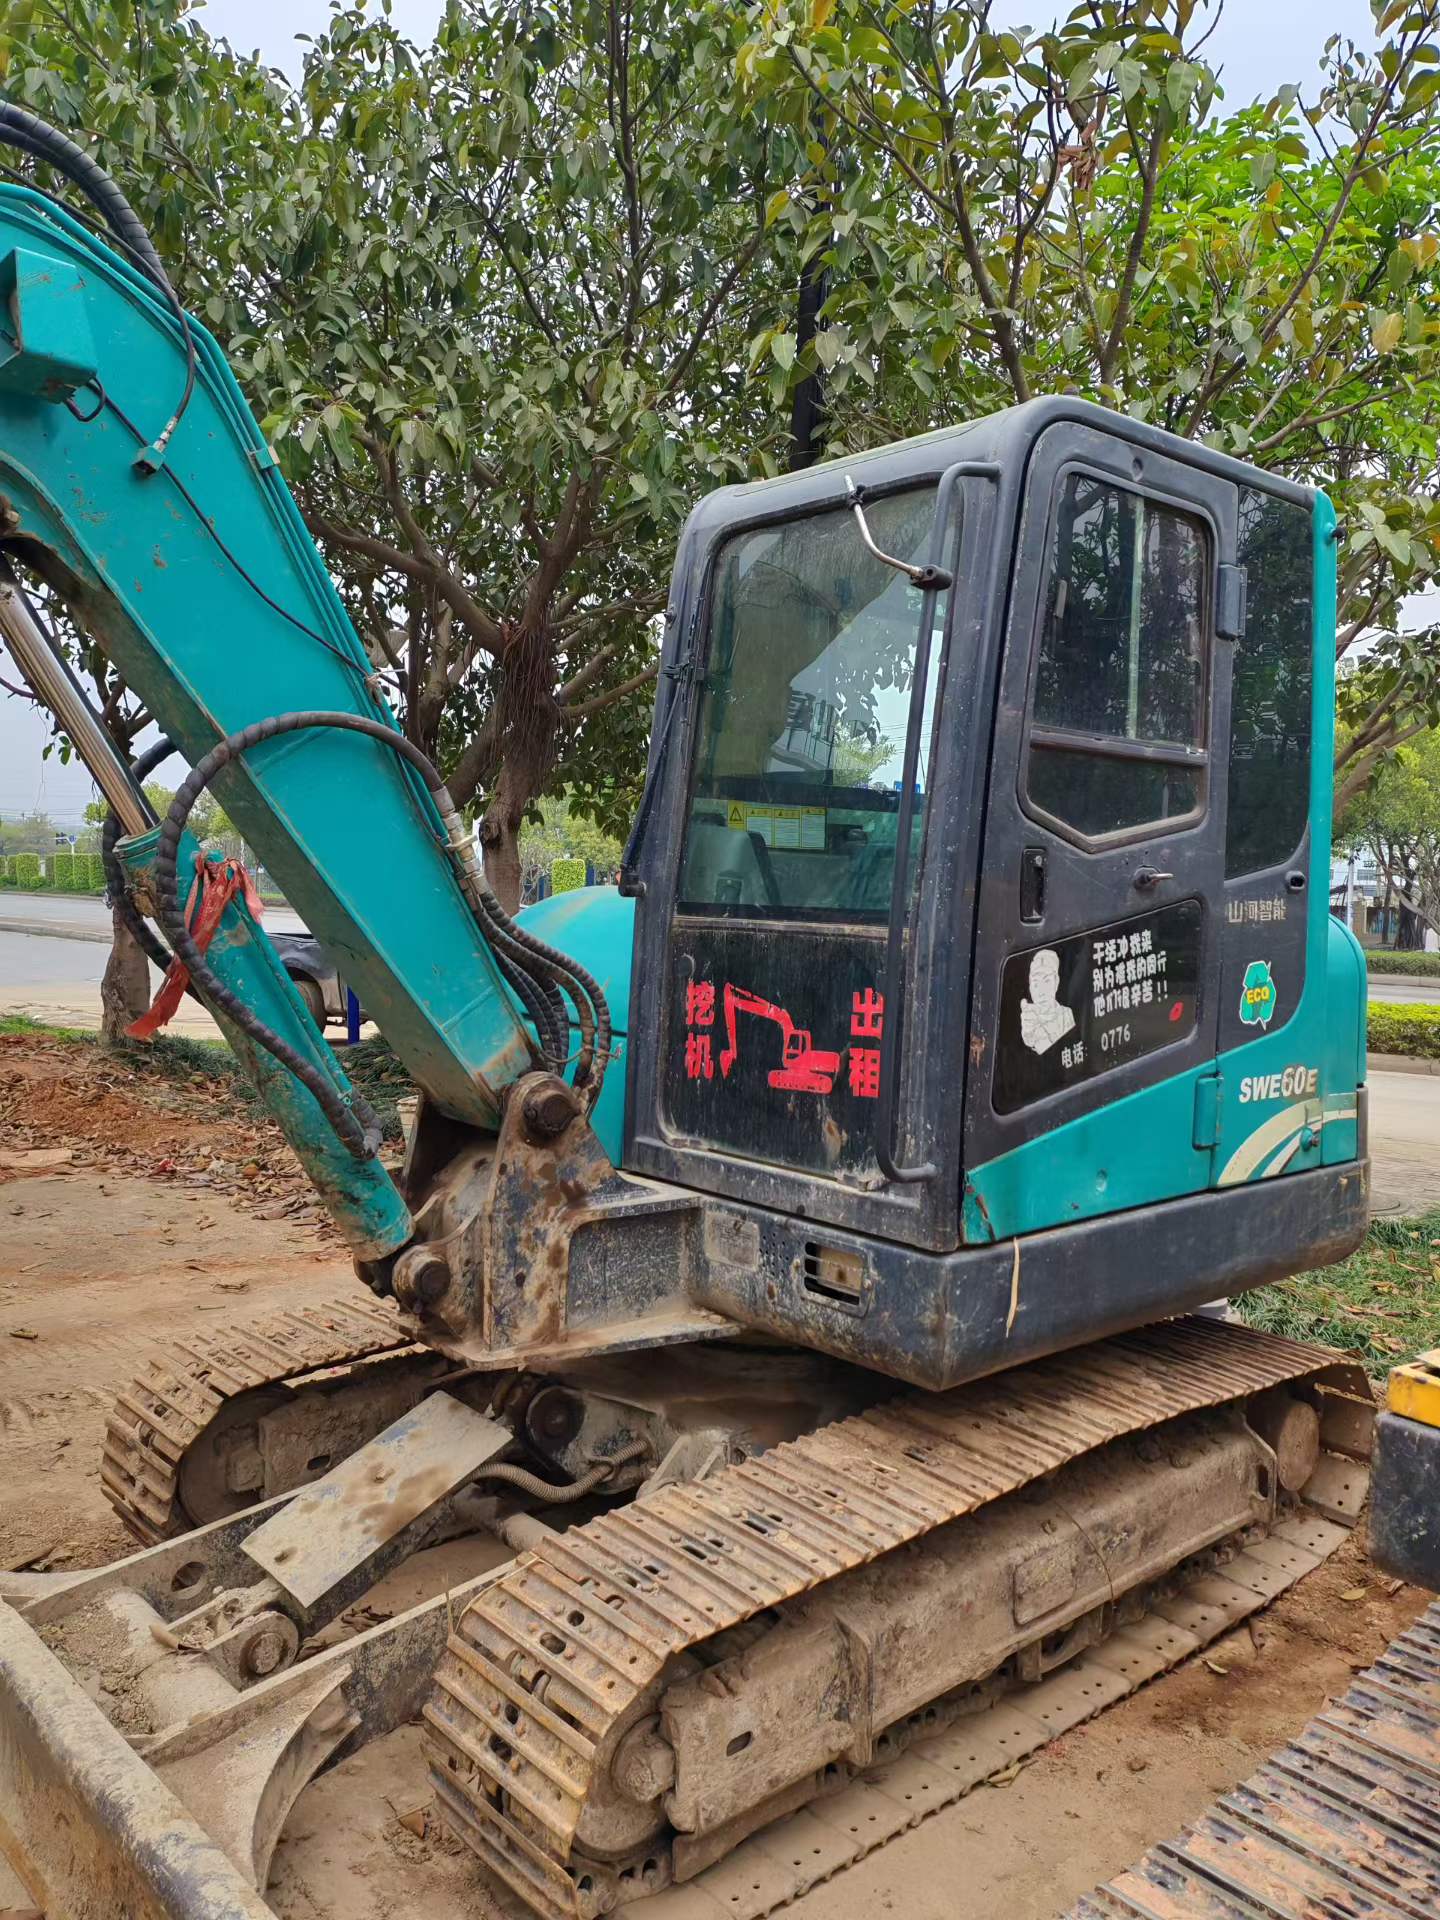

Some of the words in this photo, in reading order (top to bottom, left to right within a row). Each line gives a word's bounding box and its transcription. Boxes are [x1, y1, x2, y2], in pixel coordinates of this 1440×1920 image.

[1228, 899, 1286, 922] 山河智能
[1092, 929, 1153, 965] 干活冲我来
[1092, 950, 1167, 992] 别为难我的同行
[1246, 986, 1270, 1004] ECO
[685, 981, 716, 1080] 挖机
[849, 987, 885, 1098] 出租
[1100, 1023, 1131, 1051] 0776
[1239, 1066, 1318, 1103] SWE60E
